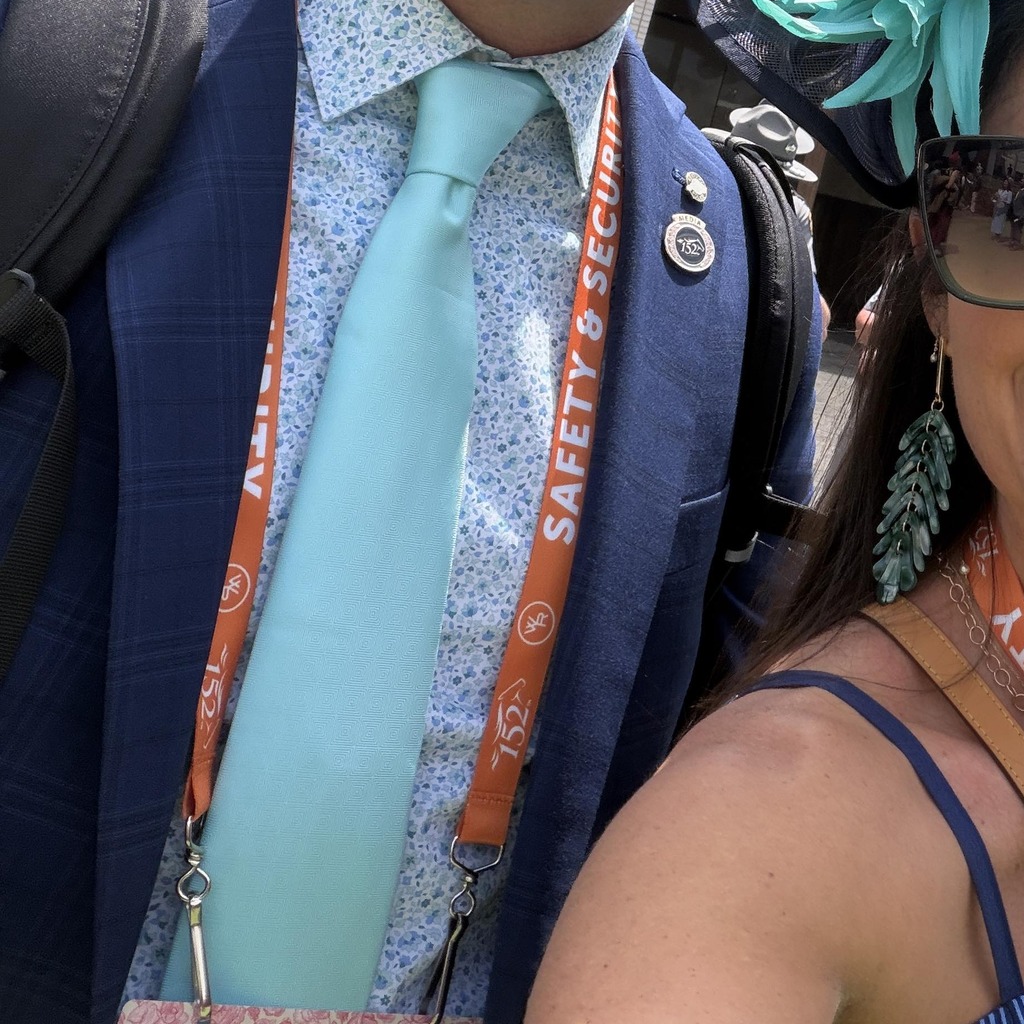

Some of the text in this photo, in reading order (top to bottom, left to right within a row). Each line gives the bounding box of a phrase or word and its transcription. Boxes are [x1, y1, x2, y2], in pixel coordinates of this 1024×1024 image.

[678, 215, 701, 226] MEDIA
[681, 242, 700, 256] 152
[543, 349, 597, 545] SAFETY
[576, 308, 603, 342] &
[500, 704, 529, 759] 152
